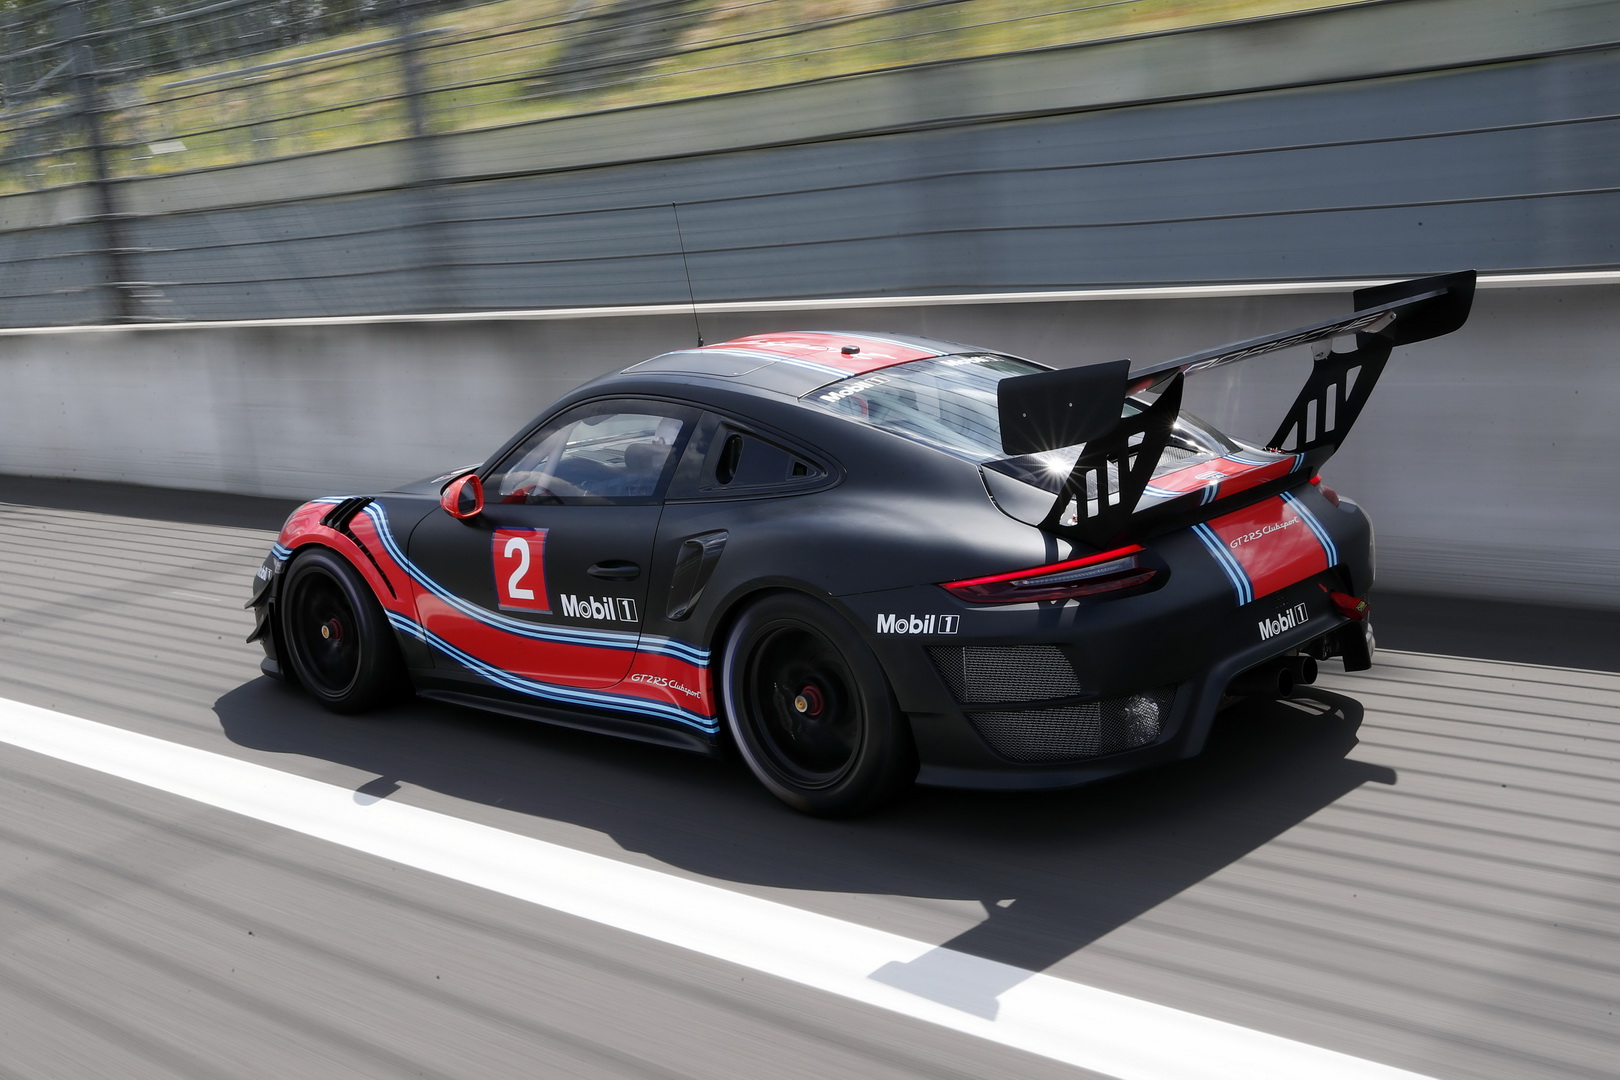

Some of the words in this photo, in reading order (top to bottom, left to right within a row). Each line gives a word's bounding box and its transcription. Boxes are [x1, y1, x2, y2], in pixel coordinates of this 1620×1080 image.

[819, 381, 874, 403] Mobil
[865, 376, 890, 385] 1
[1262, 516, 1300, 535] Clubsport
[503, 537, 535, 600] 2
[560, 593, 616, 621] Mobil
[618, 598, 637, 622] 1
[876, 613, 936, 634] Mobil
[940, 615, 957, 634] 1
[1258, 607, 1296, 641] Mobil
[1295, 603, 1308, 624] 1
[668, 680, 701, 699] Clubsport
